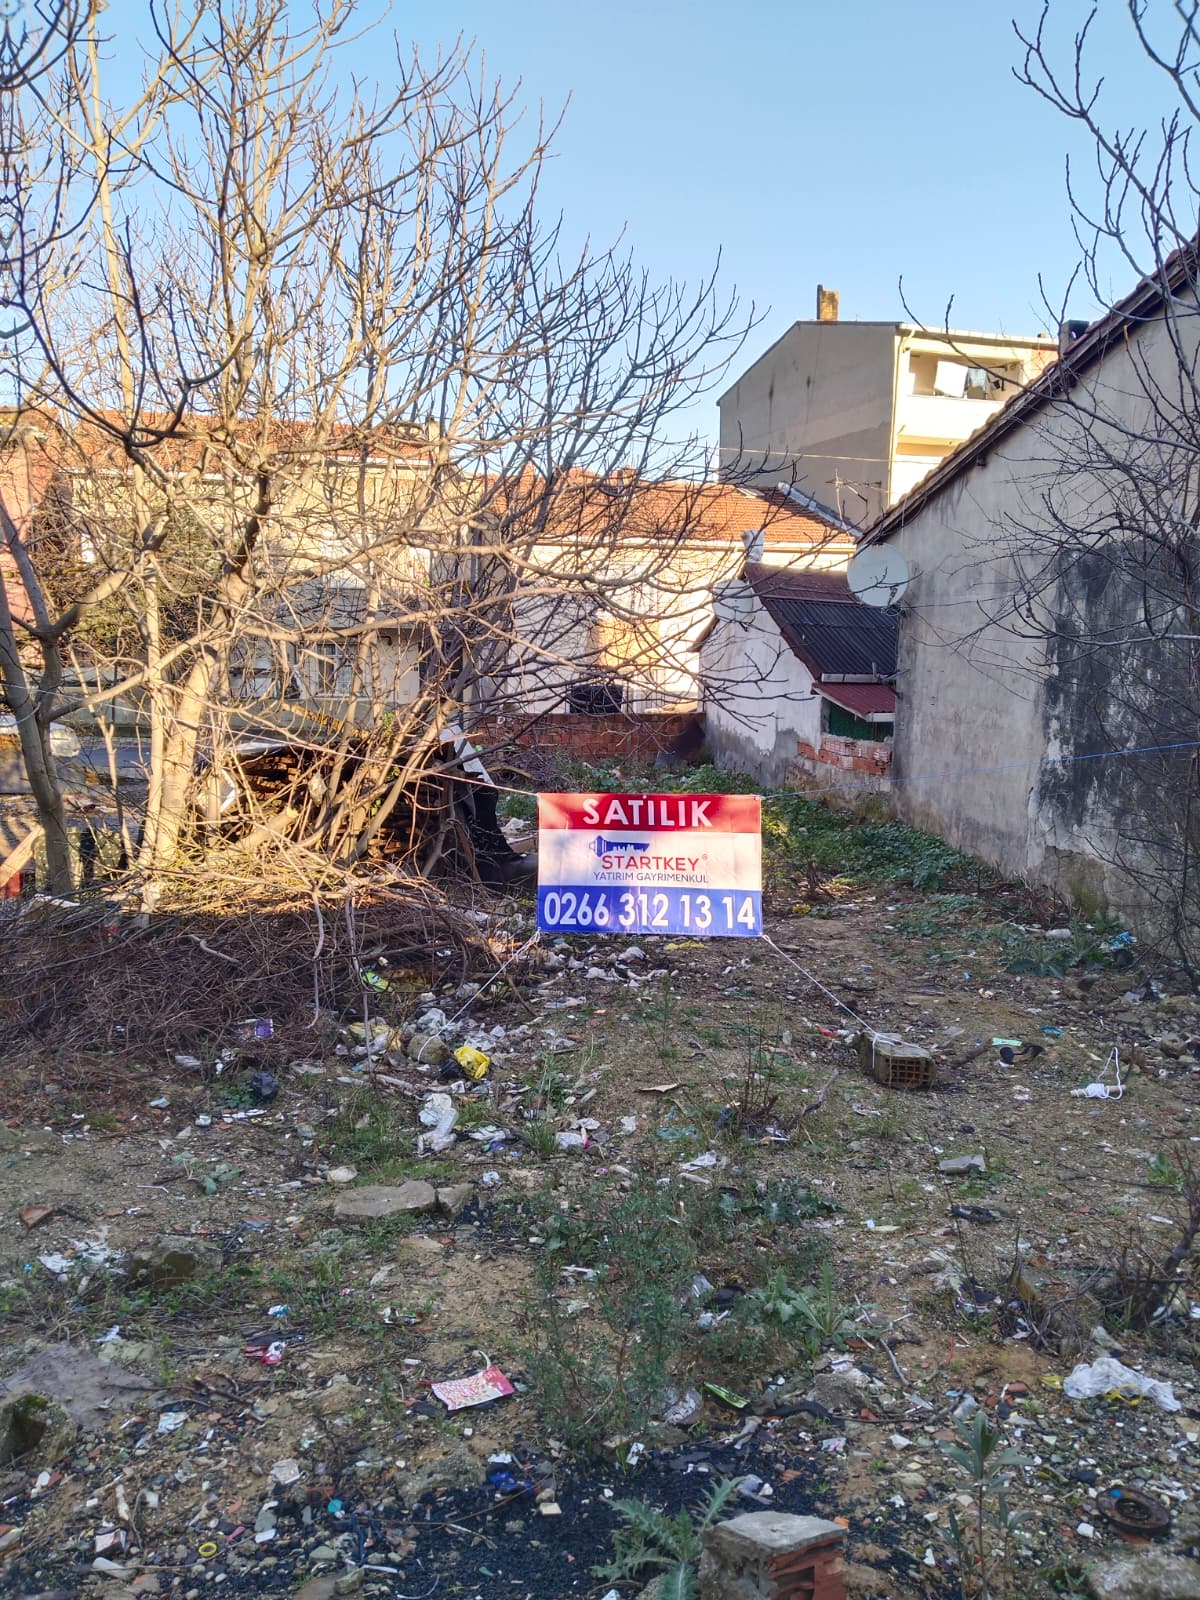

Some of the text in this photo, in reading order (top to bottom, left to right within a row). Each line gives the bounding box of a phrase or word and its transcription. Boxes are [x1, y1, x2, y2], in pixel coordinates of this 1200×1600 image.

[583, 798, 713, 827] SATILIK
[602, 855, 699, 872] STARTKEY
[593, 871, 634, 881] YATIRIM
[544, 892, 755, 930] 0266 312 13 14
